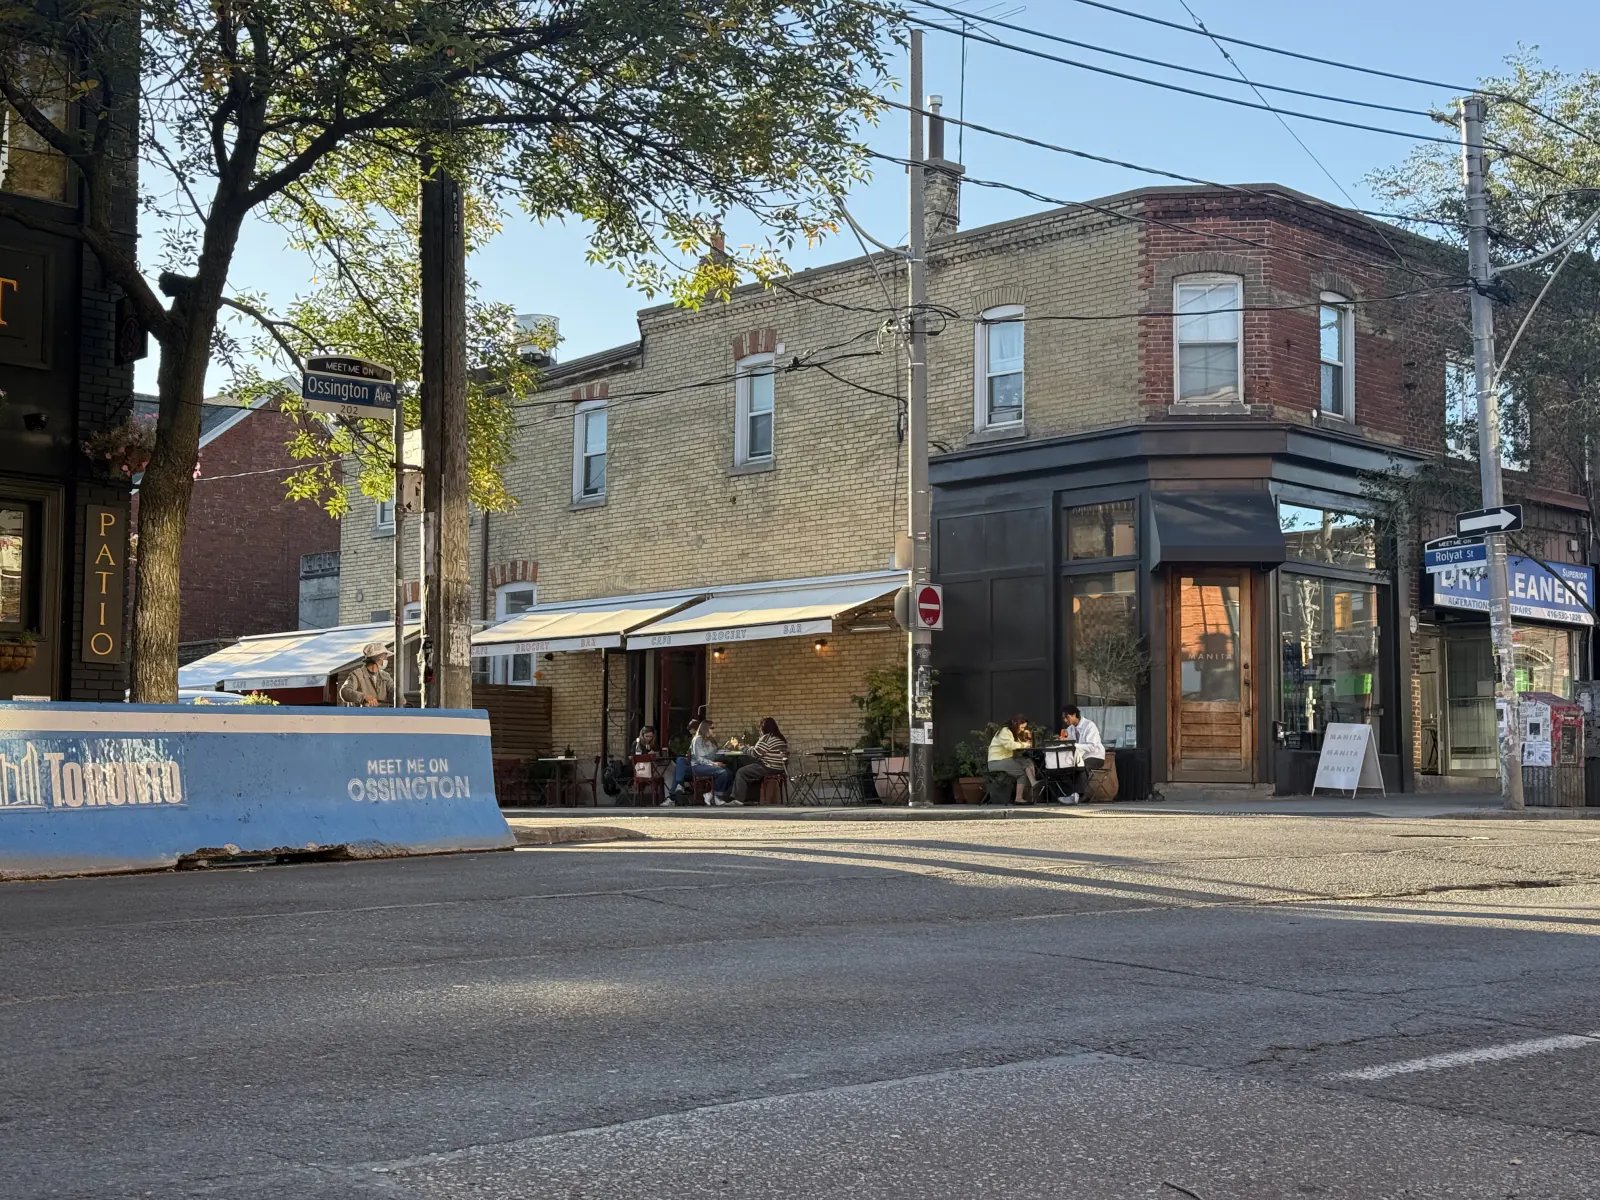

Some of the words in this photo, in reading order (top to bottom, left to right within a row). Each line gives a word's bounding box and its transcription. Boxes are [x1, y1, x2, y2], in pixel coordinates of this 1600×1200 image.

[325, 362, 346, 372] MEET
[347, 364, 360, 374] ME
[362, 367, 374, 376] ON
[307, 376, 368, 401] Ossington
[374, 388, 391, 403] Ave
[340, 404, 358, 415] 202
[1435, 549, 1463, 563] Rolyat
[1466, 549, 1474, 558] St
[1562, 568, 1588, 580] SUPERIOR
[90, 512, 116, 655] PATIO
[1510, 604, 1532, 616] EPAIRS
[650, 635, 672, 646] CAFE
[705, 629, 747, 641] GROCERY
[783, 624, 802, 634] BAR
[515, 641, 550, 652] GROCERY
[581, 638, 596, 647] BAR
[232, 680, 247, 689] CAFE
[1329, 733, 1362, 741] MANITA
[1326, 749, 1359, 757] MANITA
[367, 759, 402, 775] MEET
[407, 758, 425, 774] ME
[428, 758, 449, 773] ON
[1322, 764, 1355, 773] MANITA
[347, 775, 471, 802] OSSINGTON
